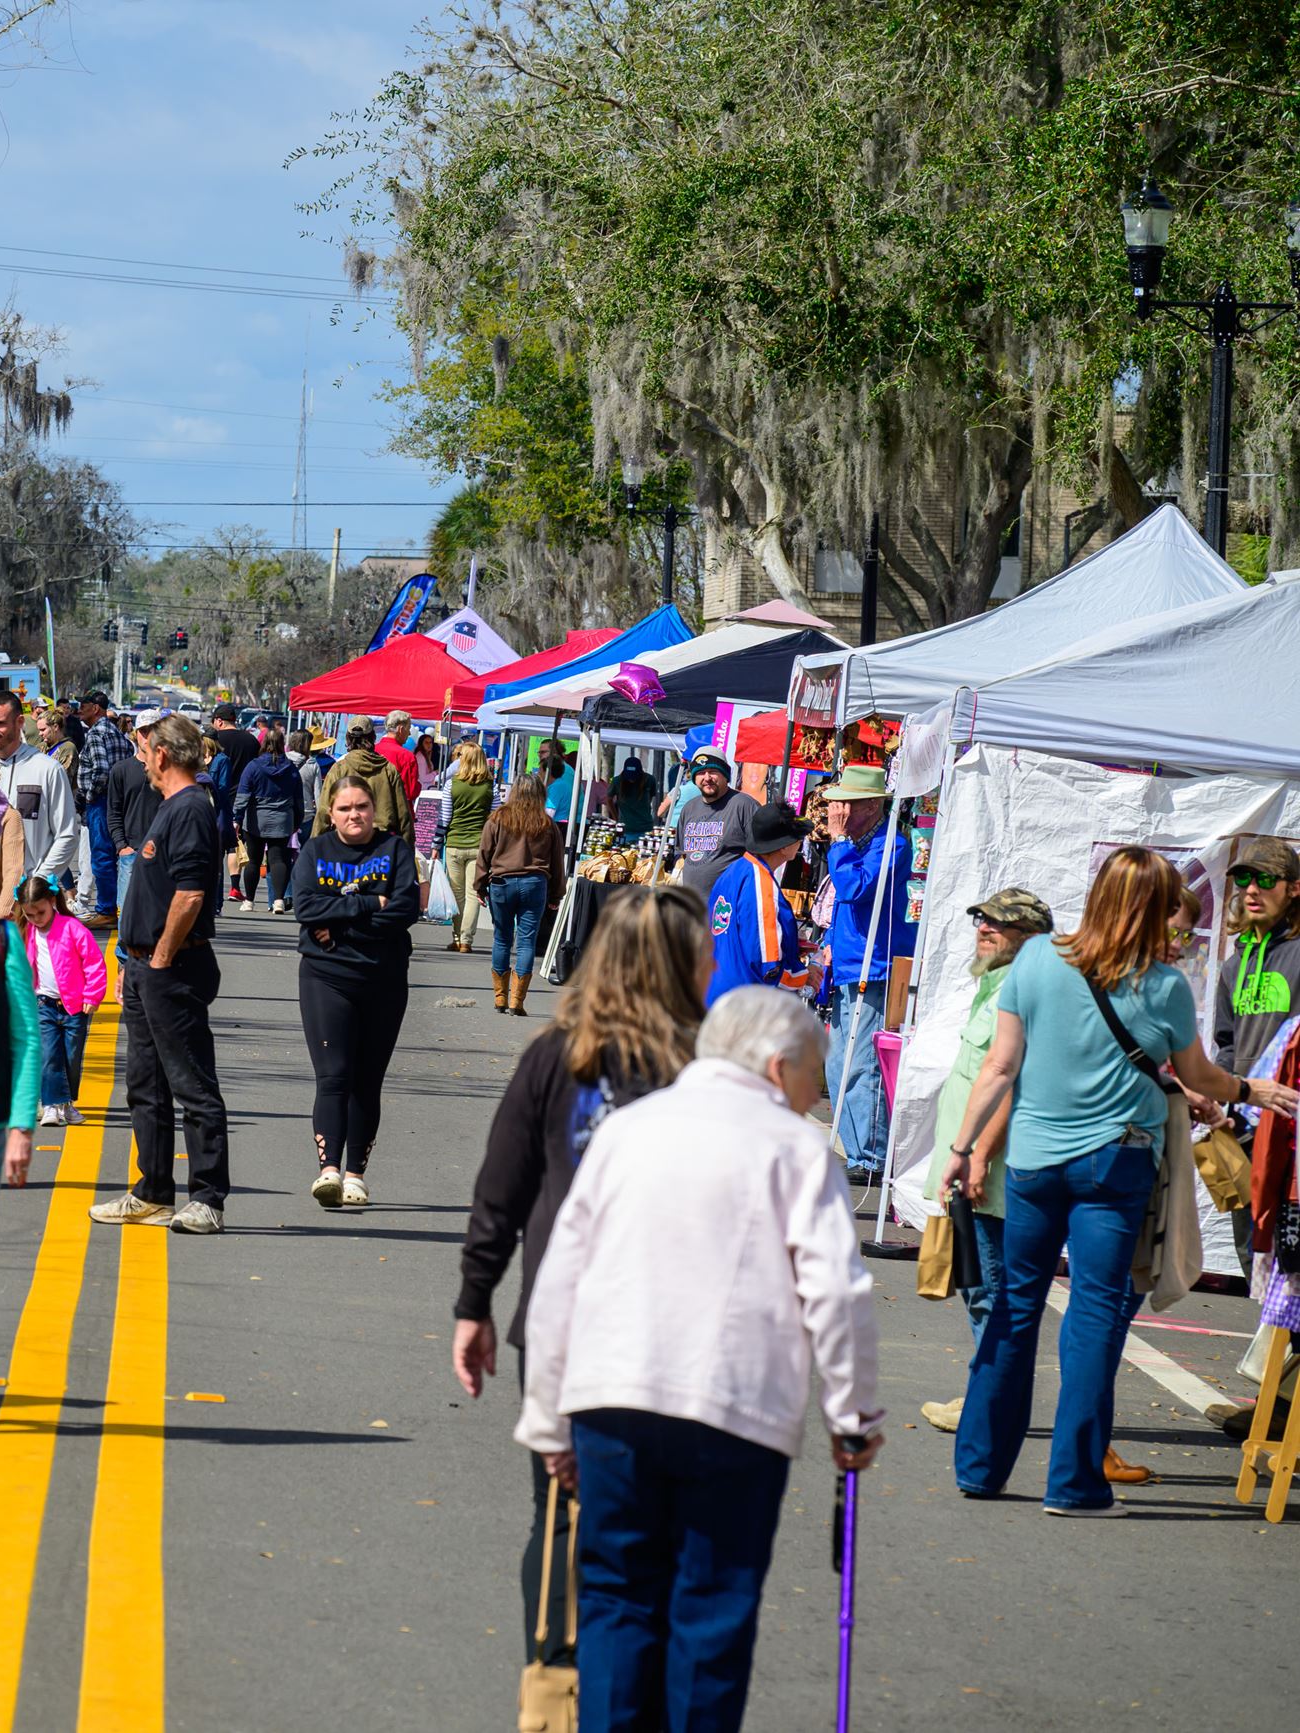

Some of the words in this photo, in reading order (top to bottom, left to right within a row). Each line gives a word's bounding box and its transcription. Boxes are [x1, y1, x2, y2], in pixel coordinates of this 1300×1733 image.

[717, 719, 729, 751] rida
[684, 820, 724, 837] FLORIDA
[683, 836, 719, 852] GATORS
[316, 855, 391, 883] PANTHERS
[1238, 1000, 1267, 1017] FACE
